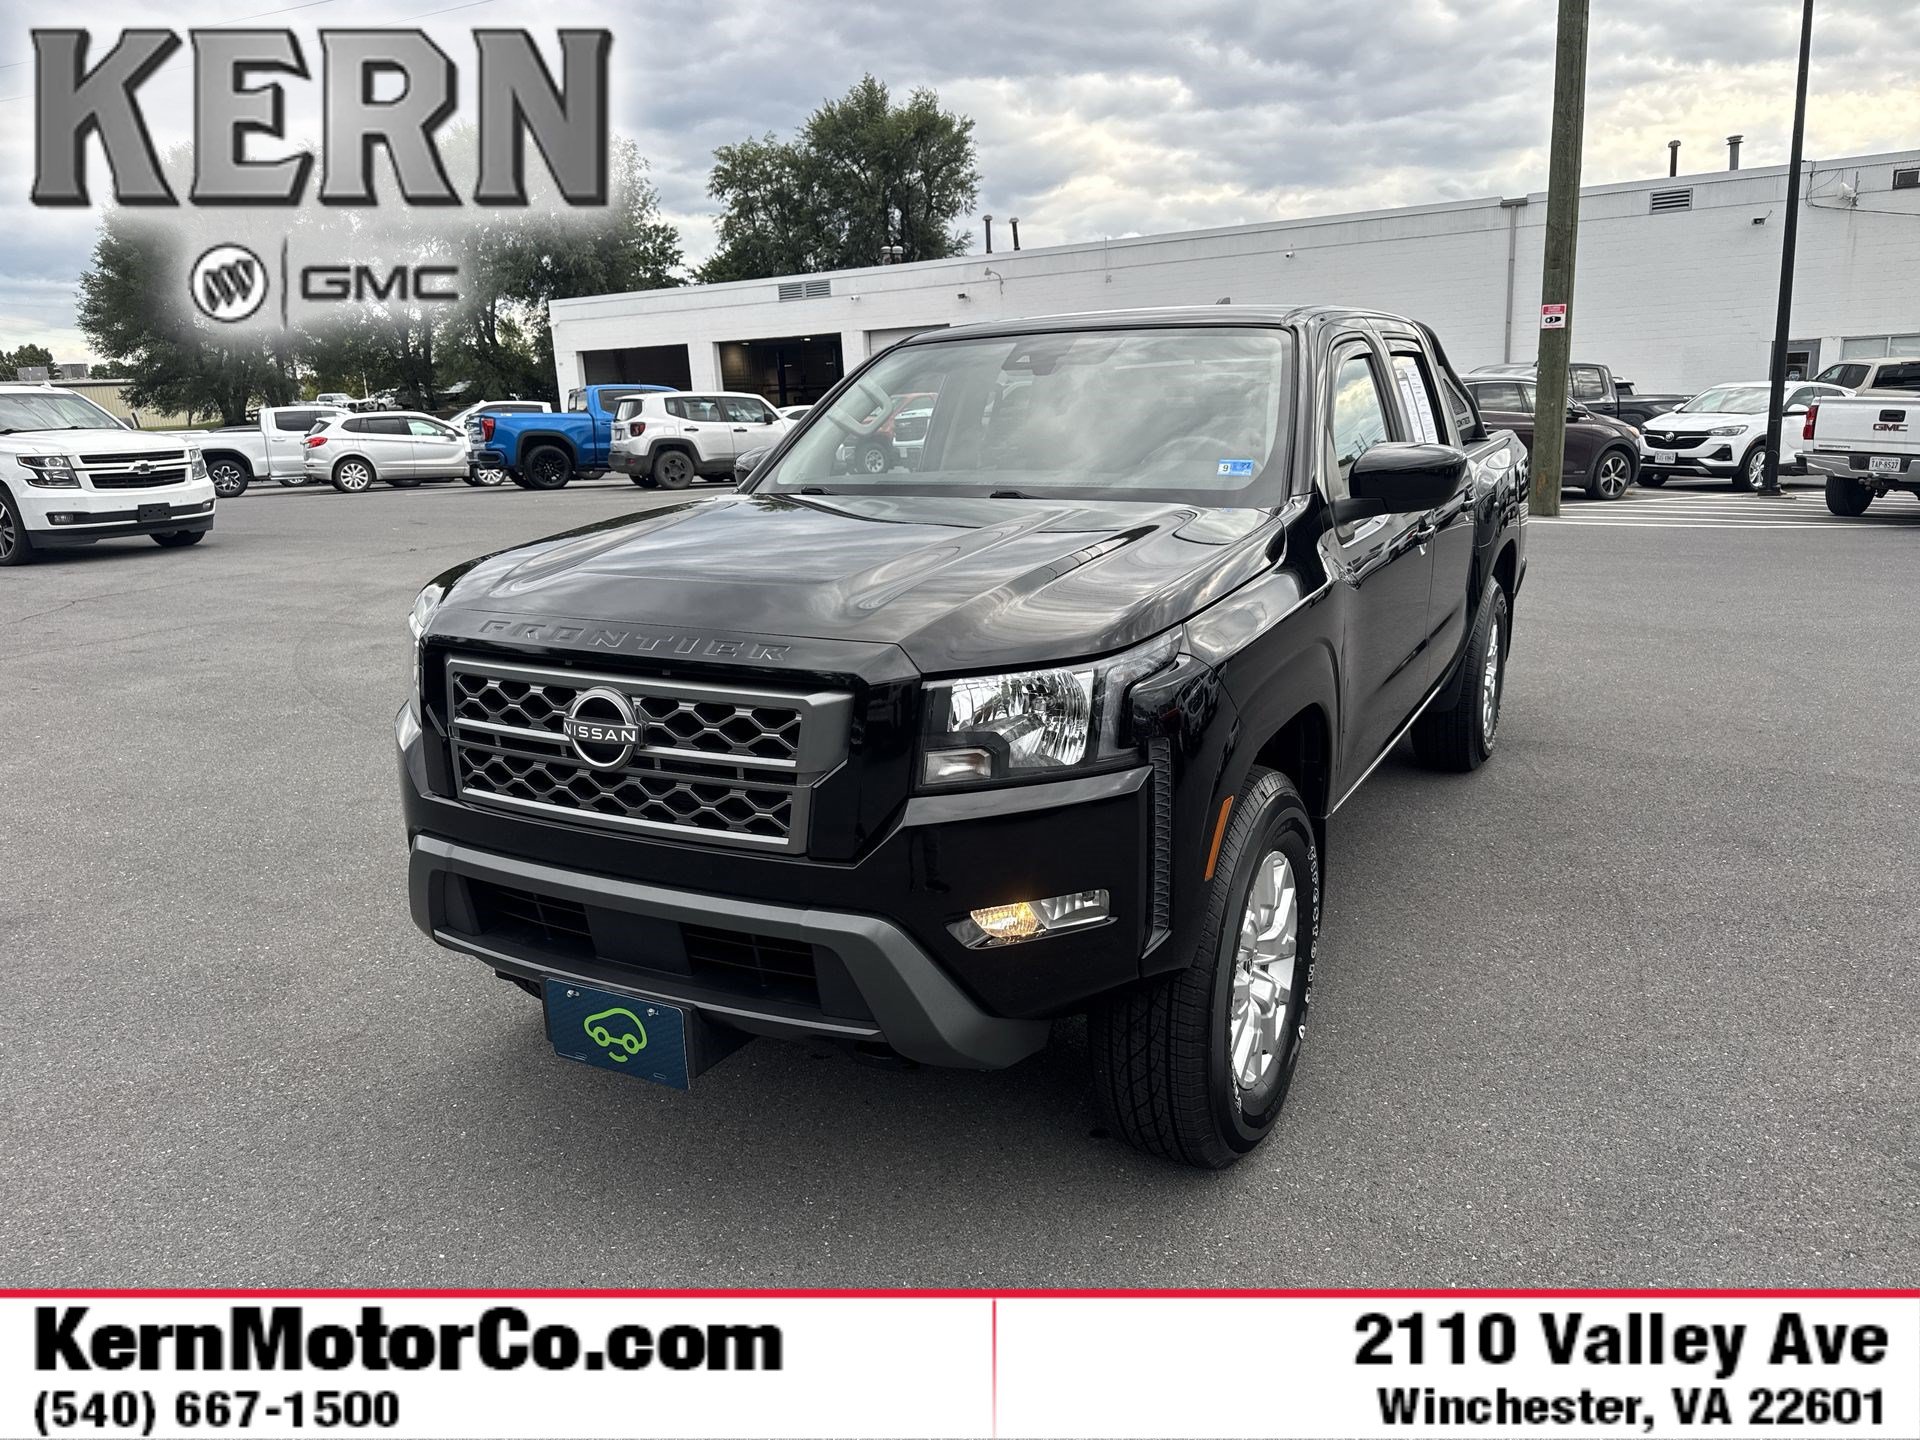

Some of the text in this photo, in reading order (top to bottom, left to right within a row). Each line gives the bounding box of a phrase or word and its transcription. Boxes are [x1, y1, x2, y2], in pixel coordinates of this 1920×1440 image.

[1873, 423, 1908, 432] GMC
[478, 619, 791, 661] FRONTIER
[563, 721, 637, 743] NISSAN
